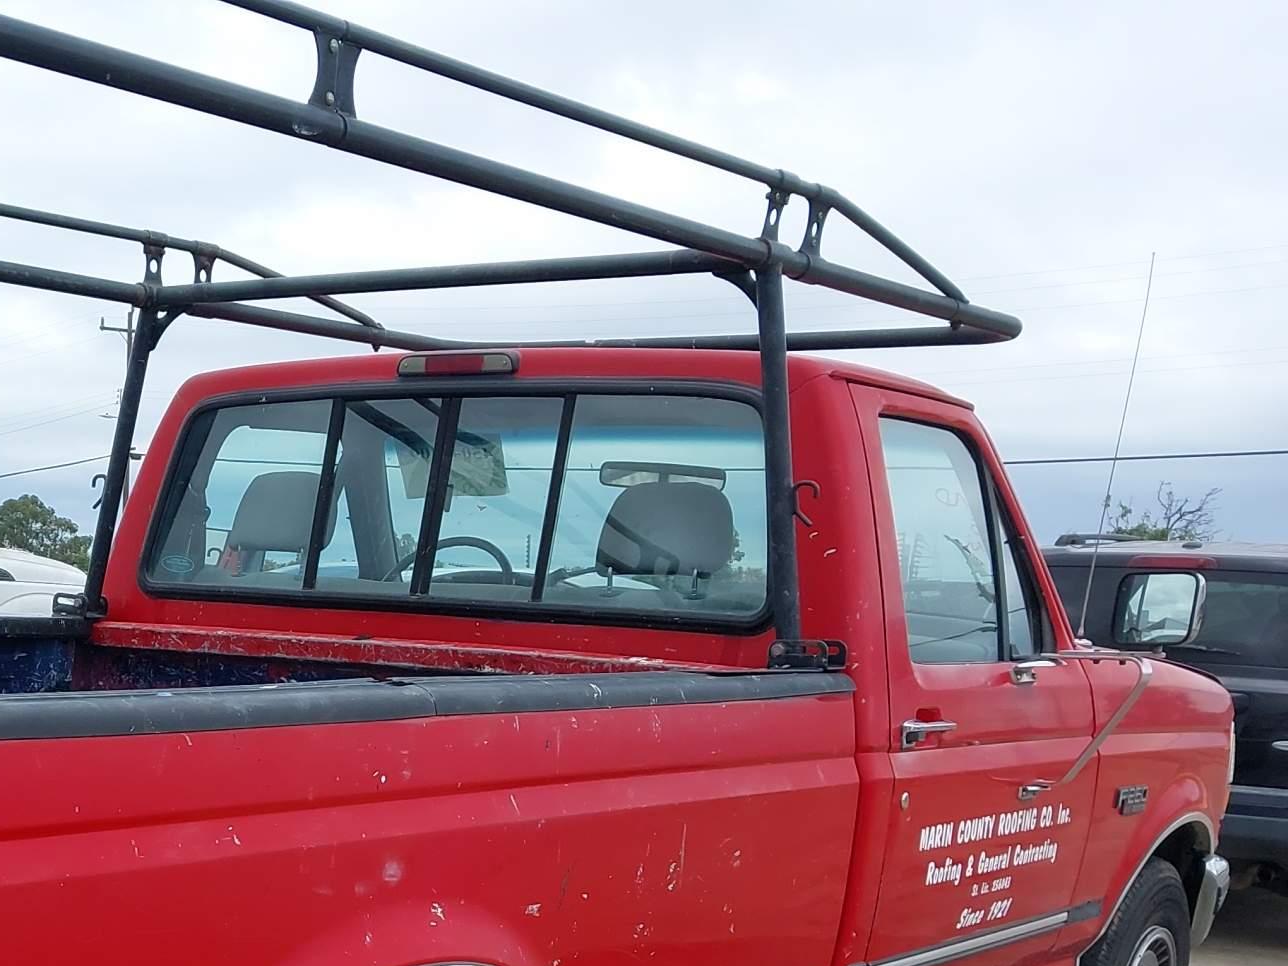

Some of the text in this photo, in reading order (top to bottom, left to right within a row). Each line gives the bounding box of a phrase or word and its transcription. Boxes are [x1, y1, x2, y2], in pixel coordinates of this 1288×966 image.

[919, 802, 1071, 852] MARIN COUNTY ROOFING CO. Inc.
[925, 839, 1058, 886] Roofing & General Contracting
[956, 897, 1013, 929] Since 1921
